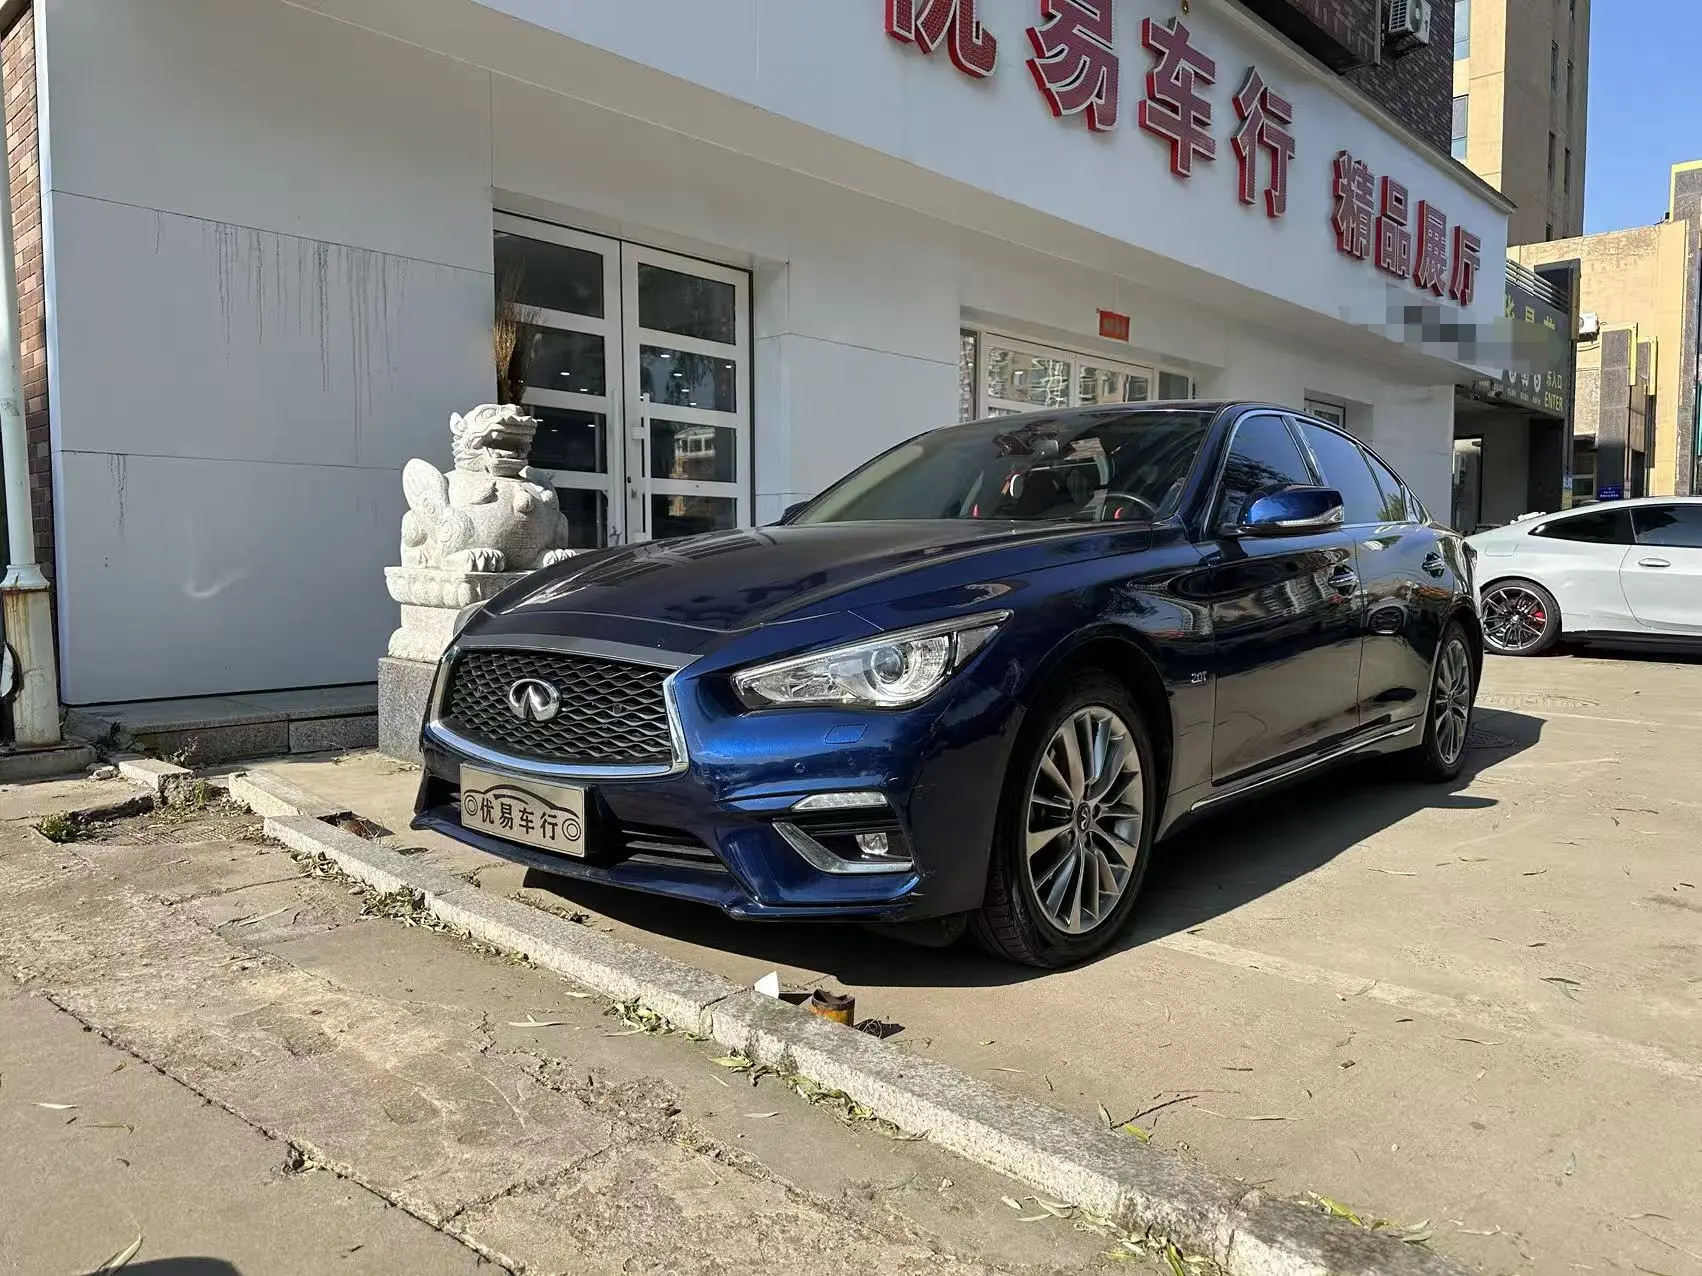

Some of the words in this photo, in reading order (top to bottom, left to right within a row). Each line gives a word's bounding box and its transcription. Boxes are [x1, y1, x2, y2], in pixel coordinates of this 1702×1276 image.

[1331, 150, 1481, 307] 精品展厅
[1544, 391, 1563, 413] ENTER
[480, 797, 559, 841] 优易车行
